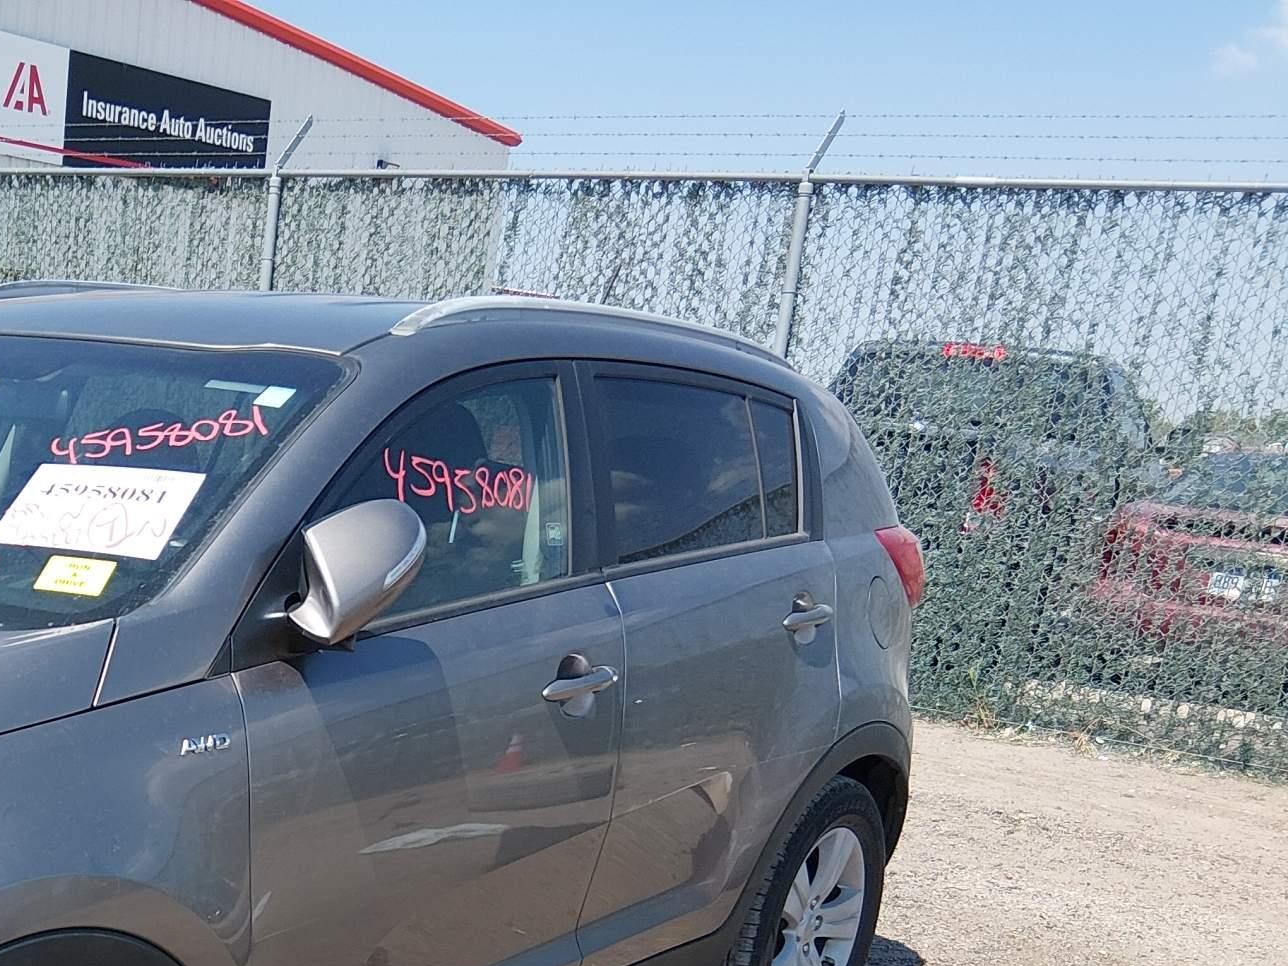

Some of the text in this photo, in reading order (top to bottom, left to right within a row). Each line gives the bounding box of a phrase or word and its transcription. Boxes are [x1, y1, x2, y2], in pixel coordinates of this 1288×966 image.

[82, 90, 254, 153] Insurance Auto Auctions
[51, 406, 268, 464] 45958081
[41, 483, 168, 504] 45958081
[384, 448, 532, 514] 45958081
